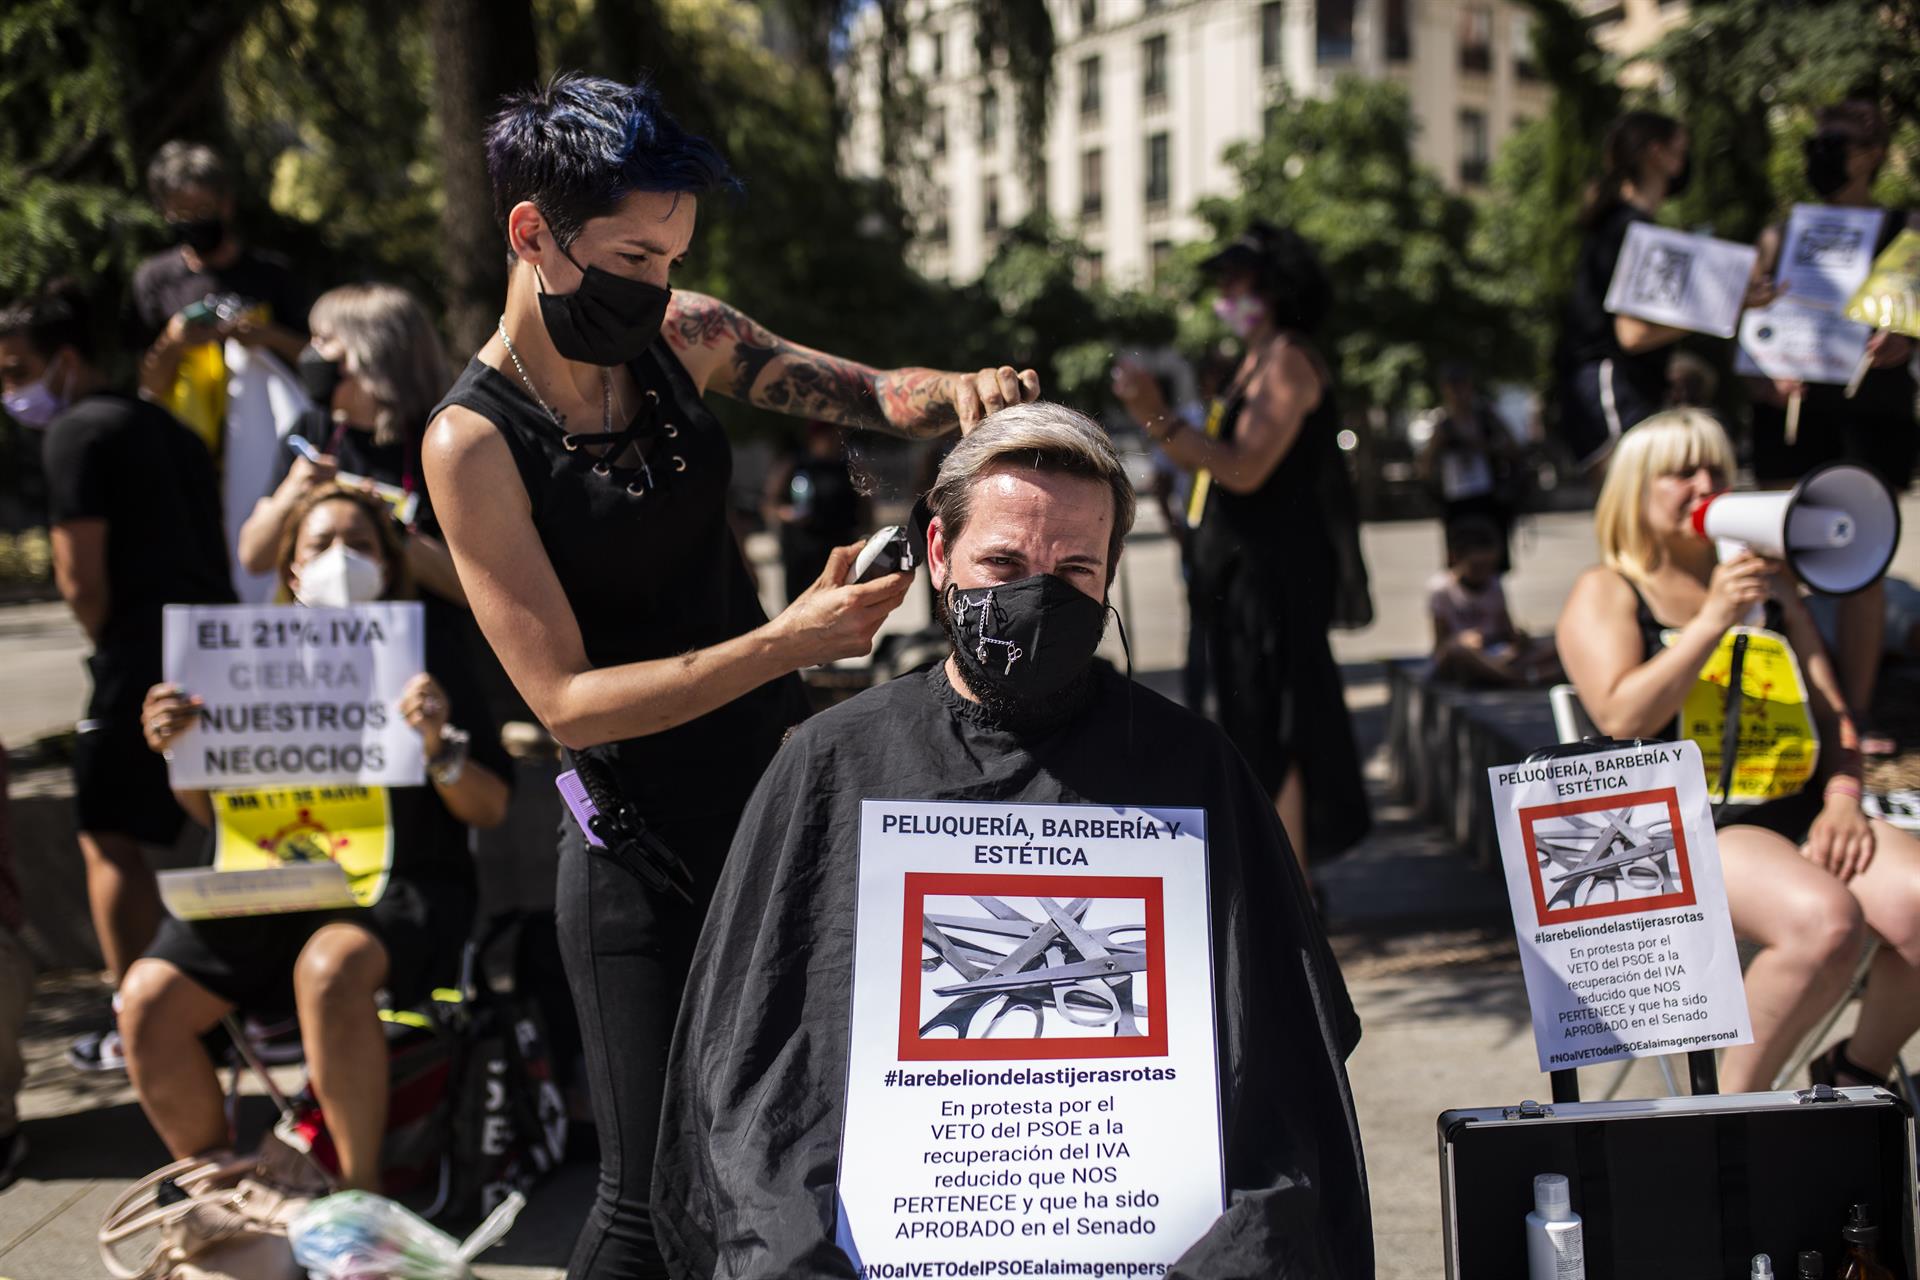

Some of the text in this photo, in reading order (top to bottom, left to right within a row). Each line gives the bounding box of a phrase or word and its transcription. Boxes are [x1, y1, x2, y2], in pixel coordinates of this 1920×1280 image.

[197, 619, 385, 648] EL 21% IVA
[229, 660, 359, 691] CIERRA
[201, 701, 387, 733] NUESTROS
[205, 743, 385, 775] NEGOCIOS
[1498, 763, 1592, 786] PELUQUERÍA,
[1596, 751, 1669, 773] BARBERÍA
[1673, 749, 1682, 761] Y
[1557, 775, 1628, 796] ESTÉTICA
[882, 813, 1181, 841] PELUQUERÍA, BARBERÍA Y
[974, 842, 1089, 866] ESTÉTICA
[1534, 911, 1704, 944] #larebeliondelastijerasrotas
[1569, 935, 1671, 959] En protesta por el
[1567, 949, 1679, 975] VETO del PSOE a la
[1567, 964, 1686, 991] recuperación del IVA
[1577, 980, 1681, 1005] reducido que NOS
[1558, 993, 1708, 1024] PERTENECE y que ha sido
[1564, 1008, 1708, 1039] APROBADO en el Senado
[1550, 1029, 1738, 1064] #NOalVETOdelPSOEalaimagenpersonal
[884, 1066, 1176, 1088] #larebeliondelastijerasrotas
[941, 1096, 1114, 1119] En protesta por el
[931, 1119, 1123, 1140] VETO del PSOE a la
[923, 1142, 1130, 1166] recuperación del IVA
[935, 1166, 1118, 1189] reducido que NOS
[893, 1190, 1159, 1215] PERTENECE y que ha sido
[895, 1216, 1156, 1239] APROBADO en el Senado
